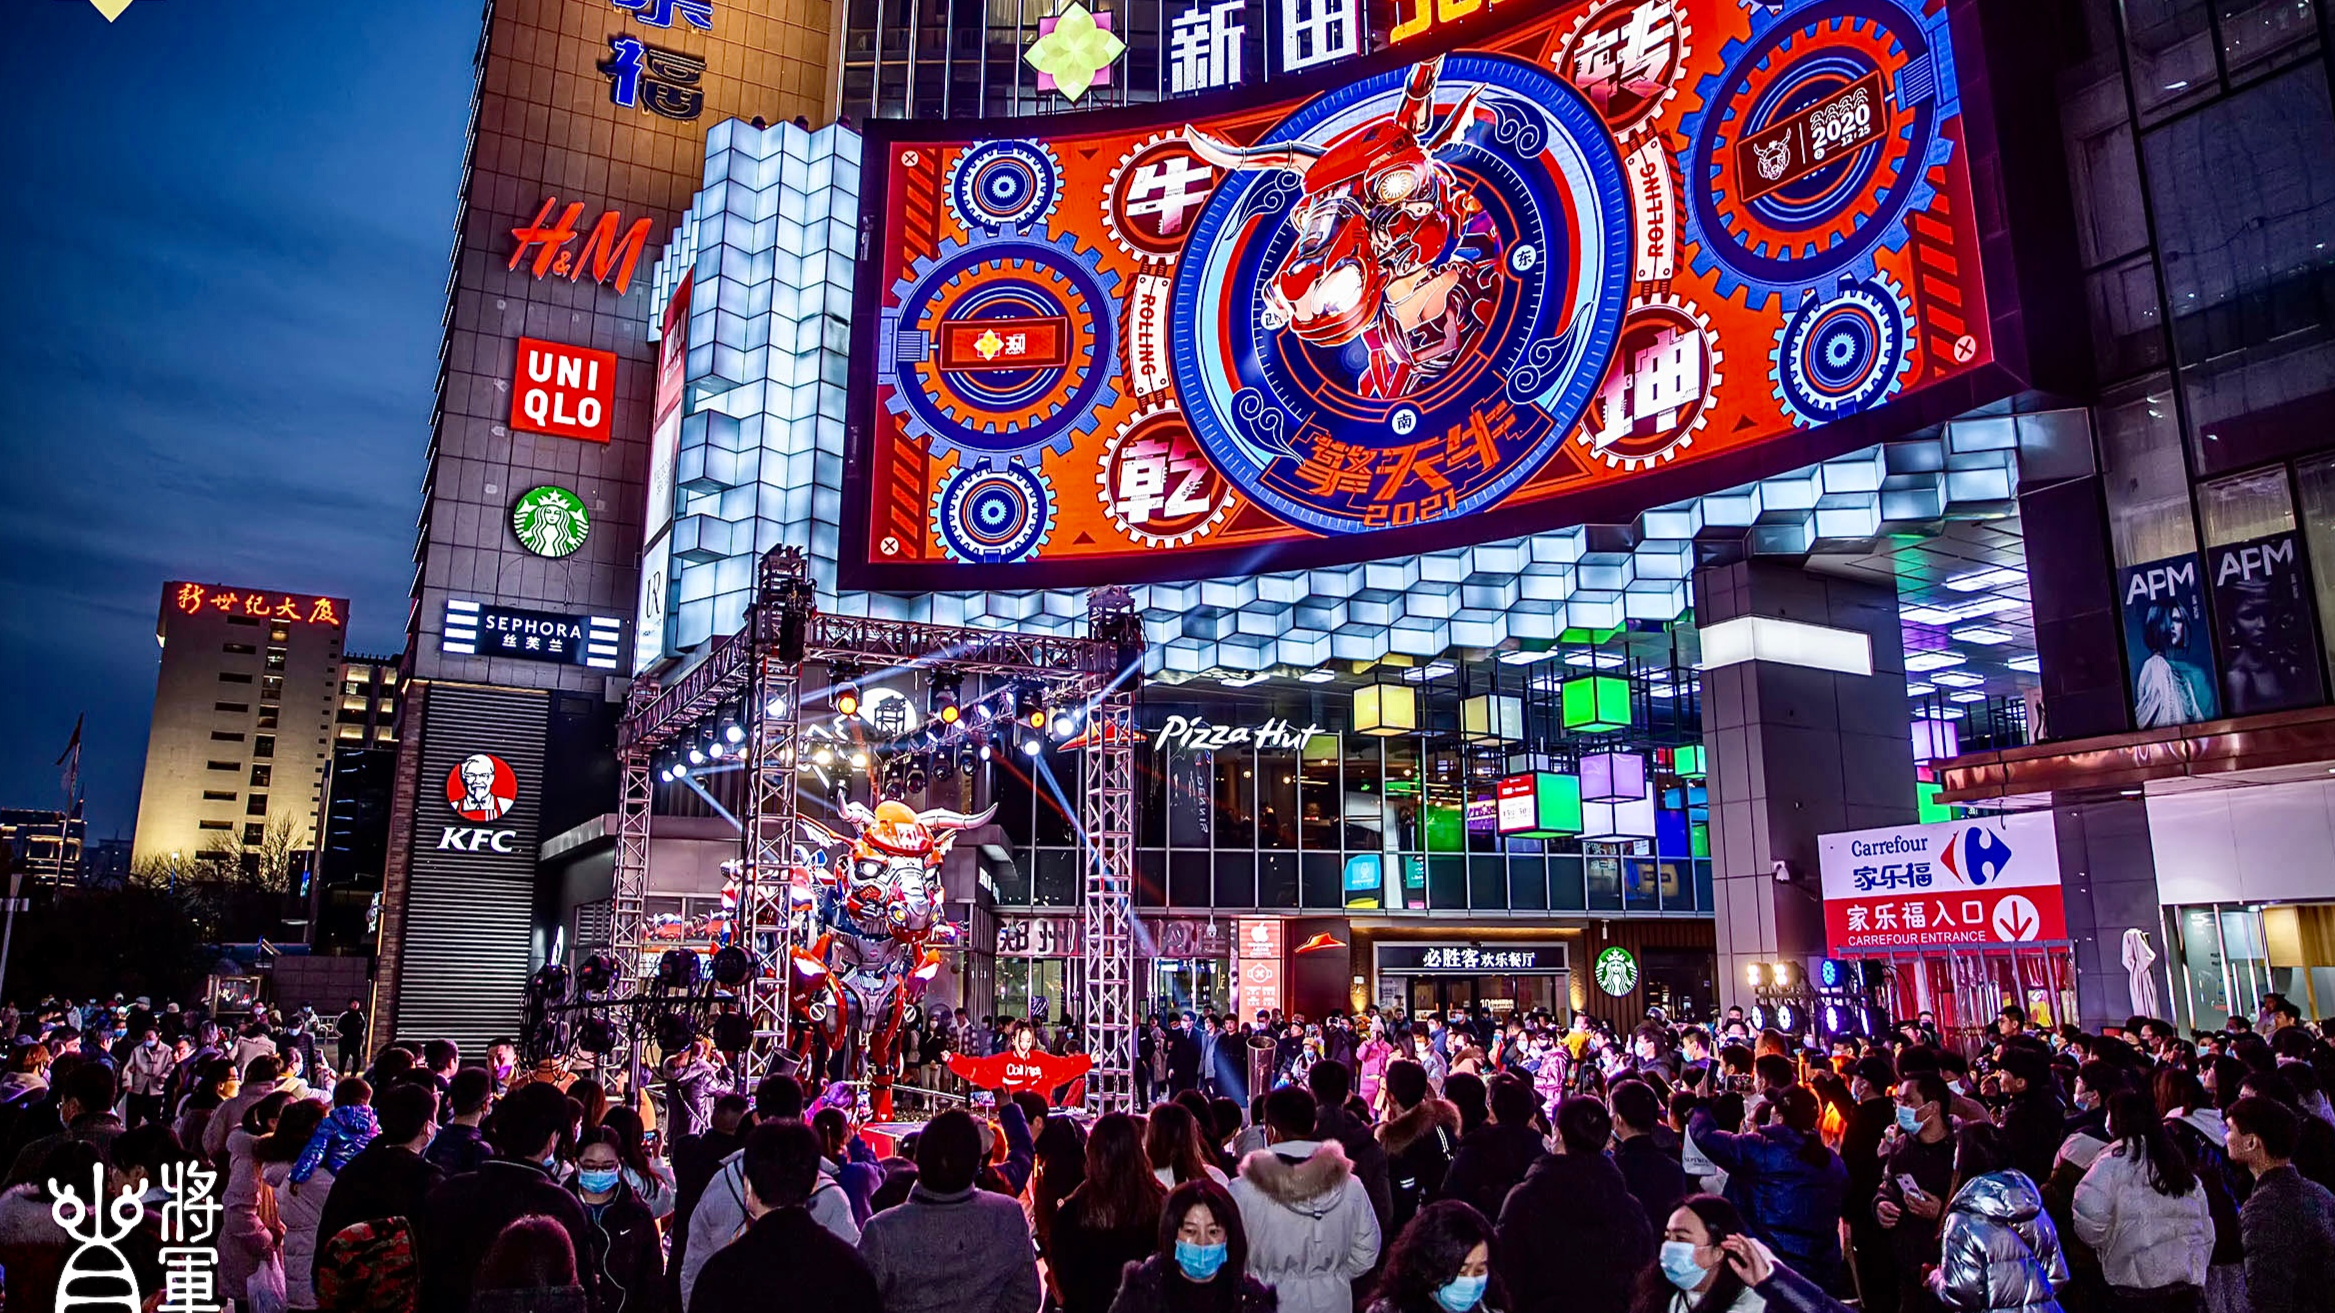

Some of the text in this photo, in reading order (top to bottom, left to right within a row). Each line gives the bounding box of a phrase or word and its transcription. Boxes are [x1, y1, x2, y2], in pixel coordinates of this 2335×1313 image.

[1811, 103, 1870, 150] 2020
[1126, 156, 1212, 235] 牛
[1640, 162, 1664, 257] ROLLING
[508, 196, 653, 297] H&M
[1516, 250, 1533, 267] 东
[663, 307, 688, 370] MUJI
[1138, 293, 1157, 376] ROLLING
[528, 350, 599, 391] UNI
[524, 389, 602, 428] QLO
[1396, 413, 1413, 430] 南
[1294, 400, 1517, 501] 擎天牛
[1115, 436, 1211, 524] 乾
[1363, 487, 1457, 527] 2021
[2217, 538, 2294, 587] APM
[2126, 562, 2195, 605] APM
[178, 583, 340, 625] 新世纪大厦
[486, 615, 582, 639] SEPHORA
[502, 633, 563, 653] 丝芙兰
[1155, 715, 1326, 751] Pizza Hut
[436, 826, 517, 853] KFC
[1851, 834, 1928, 857] Carrefour
[1853, 862, 1933, 891] 家乐福
[1846, 899, 1984, 933] 家乐福入口
[1848, 930, 1986, 946] CARREFOUR ENTRANCE
